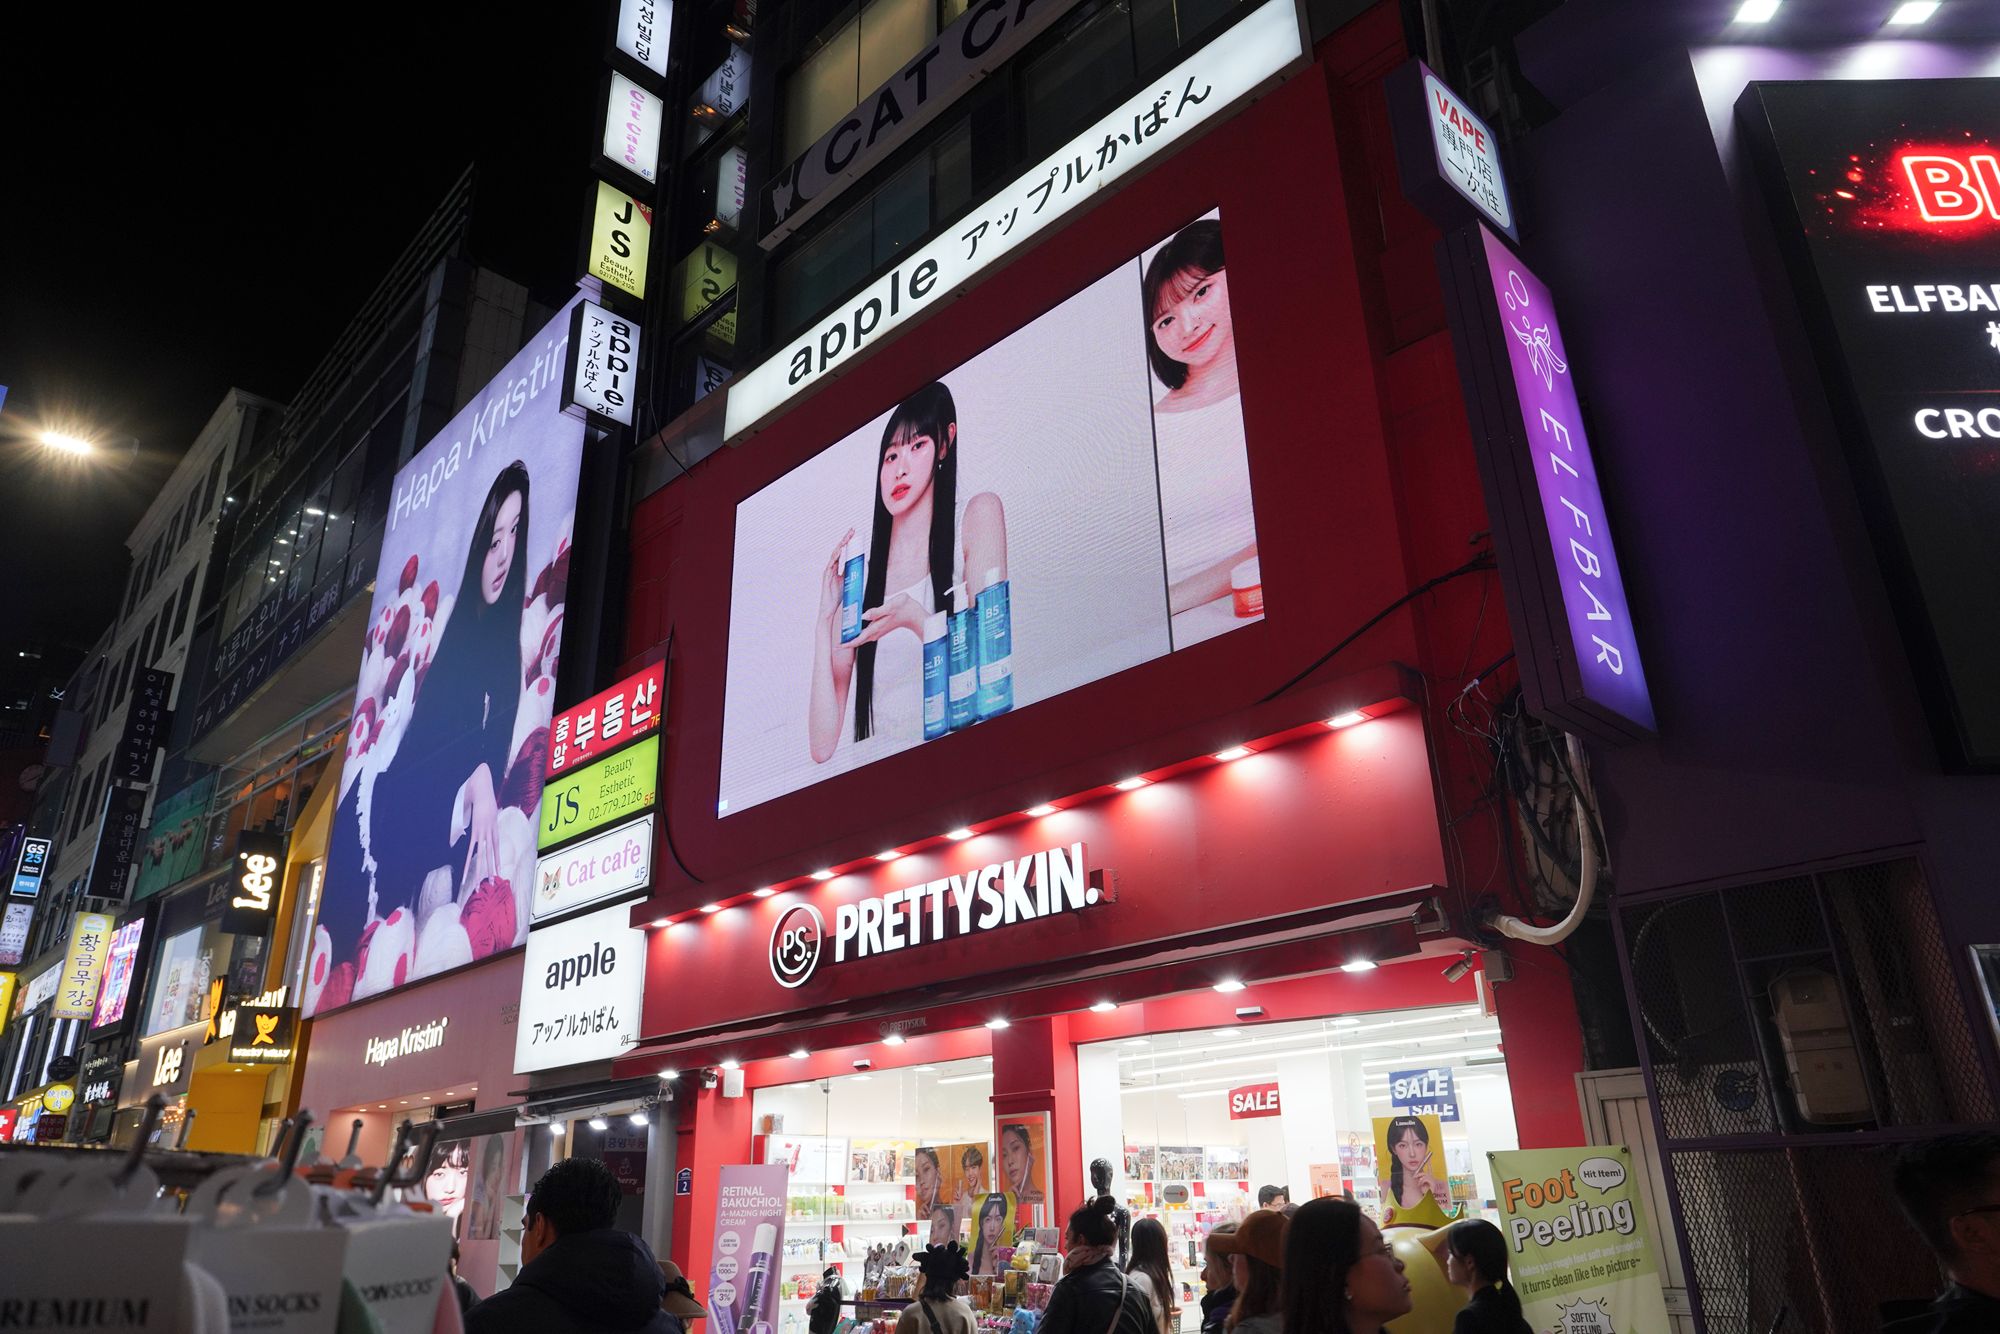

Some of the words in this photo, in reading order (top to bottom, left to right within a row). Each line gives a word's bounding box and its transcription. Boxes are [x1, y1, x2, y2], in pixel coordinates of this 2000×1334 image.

[636, 0, 655, 62] 성빌딩
[824, 48, 940, 175] CAT
[1435, 89, 1486, 155] VAPE
[1447, 157, 1501, 216] 一次性
[640, 203, 653, 213] 5F
[787, 258, 939, 387] apple
[962, 76, 1212, 261] アップルかばん
[600, 261, 636, 285] Esthetic
[603, 255, 634, 276] Beauty
[603, 320, 632, 407] apple
[596, 404, 614, 415] 2F
[392, 441, 462, 531] Hapa
[1540, 407, 1623, 676] ELFBAR
[985, 605, 999, 619] B5
[953, 630, 966, 646] B5
[552, 717, 569, 770] 중앙
[574, 678, 657, 750] 부동산
[651, 713, 661, 728] 7F
[604, 757, 635, 779] Beauty
[599, 775, 636, 799] Esthetic
[643, 792, 655, 806] 5F
[548, 785, 581, 832] JS
[589, 788, 643, 822] 02.779.2126
[25, 853, 43, 864] 25
[26, 843, 46, 854] GS
[567, 857, 596, 888] Cat
[602, 839, 642, 875] cafe
[634, 866, 646, 881] 4F
[233, 852, 278, 911] Lee
[835, 842, 1100, 962] PRETTYSKIN.
[66, 933, 101, 1007] 황금목장
[545, 941, 616, 991] apple
[532, 1005, 620, 1046] アップルかばん
[364, 1034, 399, 1067] Hapa
[399, 1021, 444, 1056] Kristin
[152, 1045, 183, 1087] Lee
[1393, 1070, 1450, 1100] SALE
[1232, 1090, 1279, 1113] SALE
[1411, 1103, 1455, 1117] SALE
[1583, 1169, 1598, 1179] Hit
[1597, 1168, 1622, 1178] Item!
[682, 1181, 688, 1192] 2
[722, 1186, 765, 1197] RETINAL
[1502, 1167, 1579, 1215] Foot
[720, 1209, 758, 1218] A-MAZING
[759, 1209, 783, 1217] NIGHT
[721, 1197, 783, 1208] BAKUCHIOL
[720, 1218, 746, 1226] CREAM
[1509, 1198, 1636, 1254] Peeling
[1521, 1282, 1530, 1295] It
[1529, 1279, 1551, 1294] turns
[1552, 1273, 1574, 1288] clean
[1574, 1268, 1590, 1282] like
[1590, 1265, 1605, 1278] the
[719, 1293, 731, 1302] 3%
[1570, 1312, 1597, 1323] SOFTLY
[1571, 1324, 1602, 1334] PEELING
